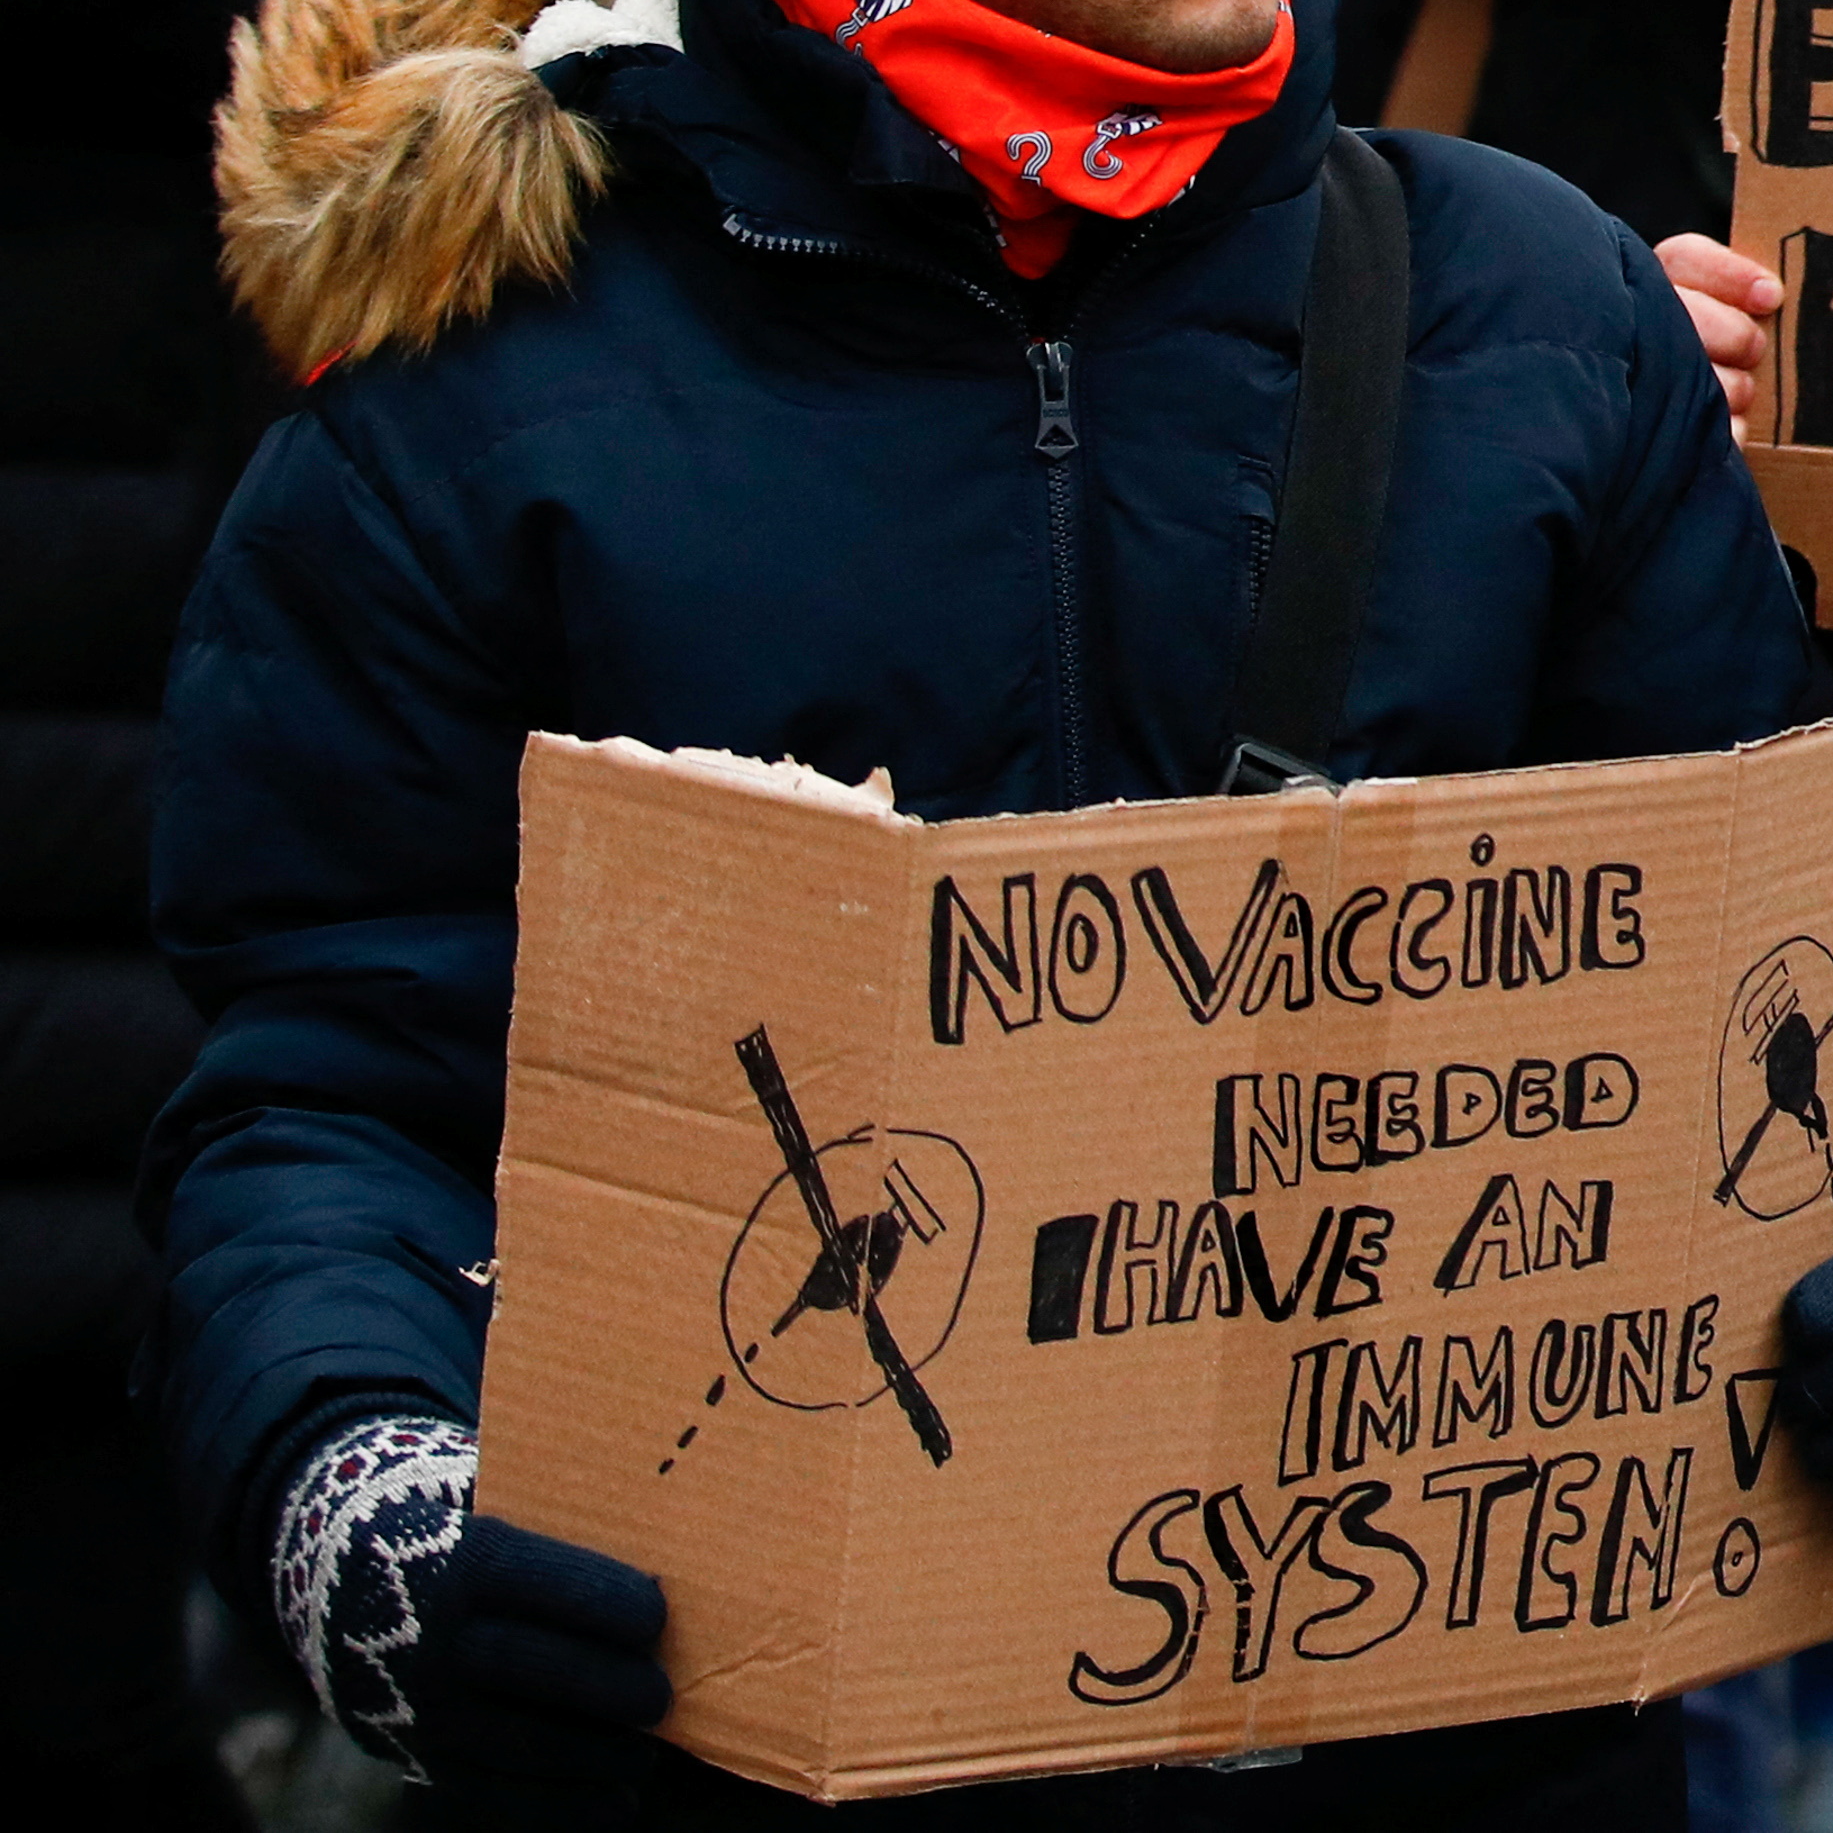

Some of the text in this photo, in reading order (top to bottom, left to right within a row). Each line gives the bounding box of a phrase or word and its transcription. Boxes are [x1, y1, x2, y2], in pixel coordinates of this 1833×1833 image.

[1214, 1052, 1640, 1199] NEEDED
[1094, 1198, 1396, 1333] HAVE
[1432, 1173, 1613, 1293] AN
[1278, 1294, 1720, 1487] IMMUNE
